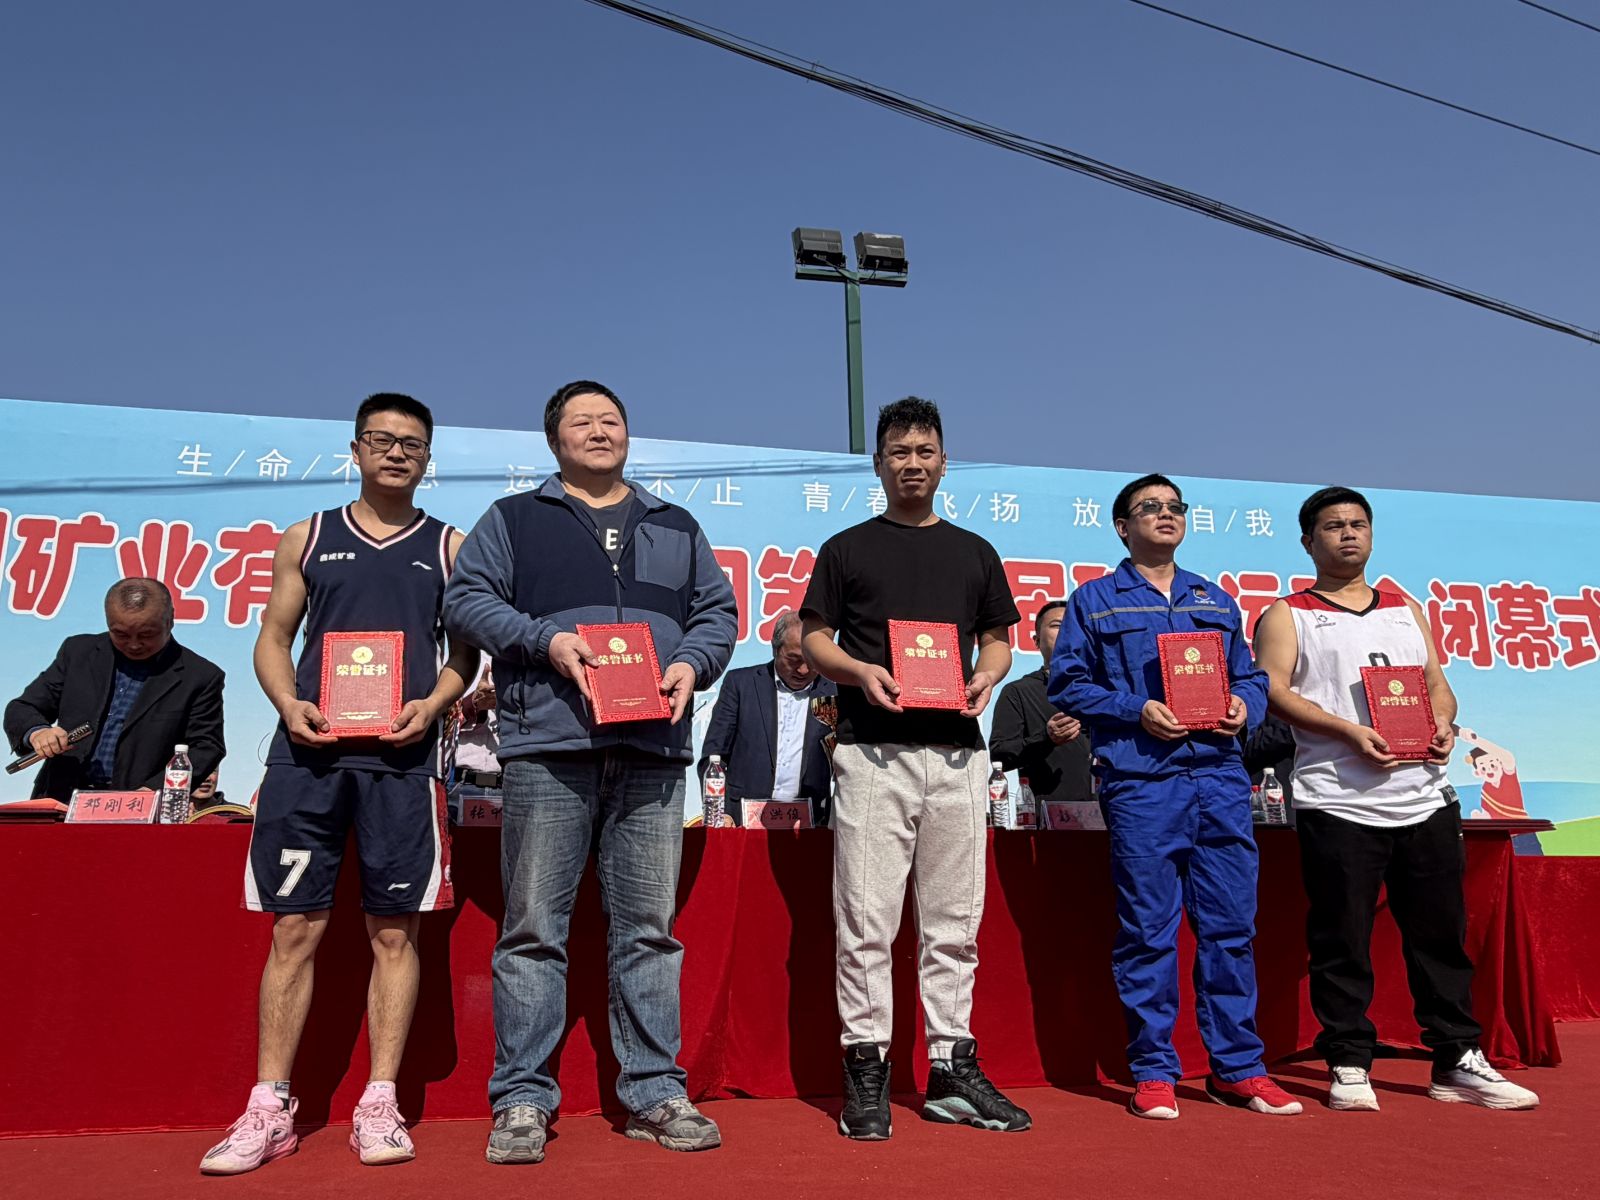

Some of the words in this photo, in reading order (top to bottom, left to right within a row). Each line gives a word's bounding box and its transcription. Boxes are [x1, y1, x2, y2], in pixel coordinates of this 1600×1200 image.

[597, 653, 644, 665] 荣誉证书
[904, 647, 948, 659] 荣誉证书
[336, 663, 388, 676] 荣誉证书
[1174, 663, 1215, 676] 荣誉证书
[276, 848, 312, 897] 7
